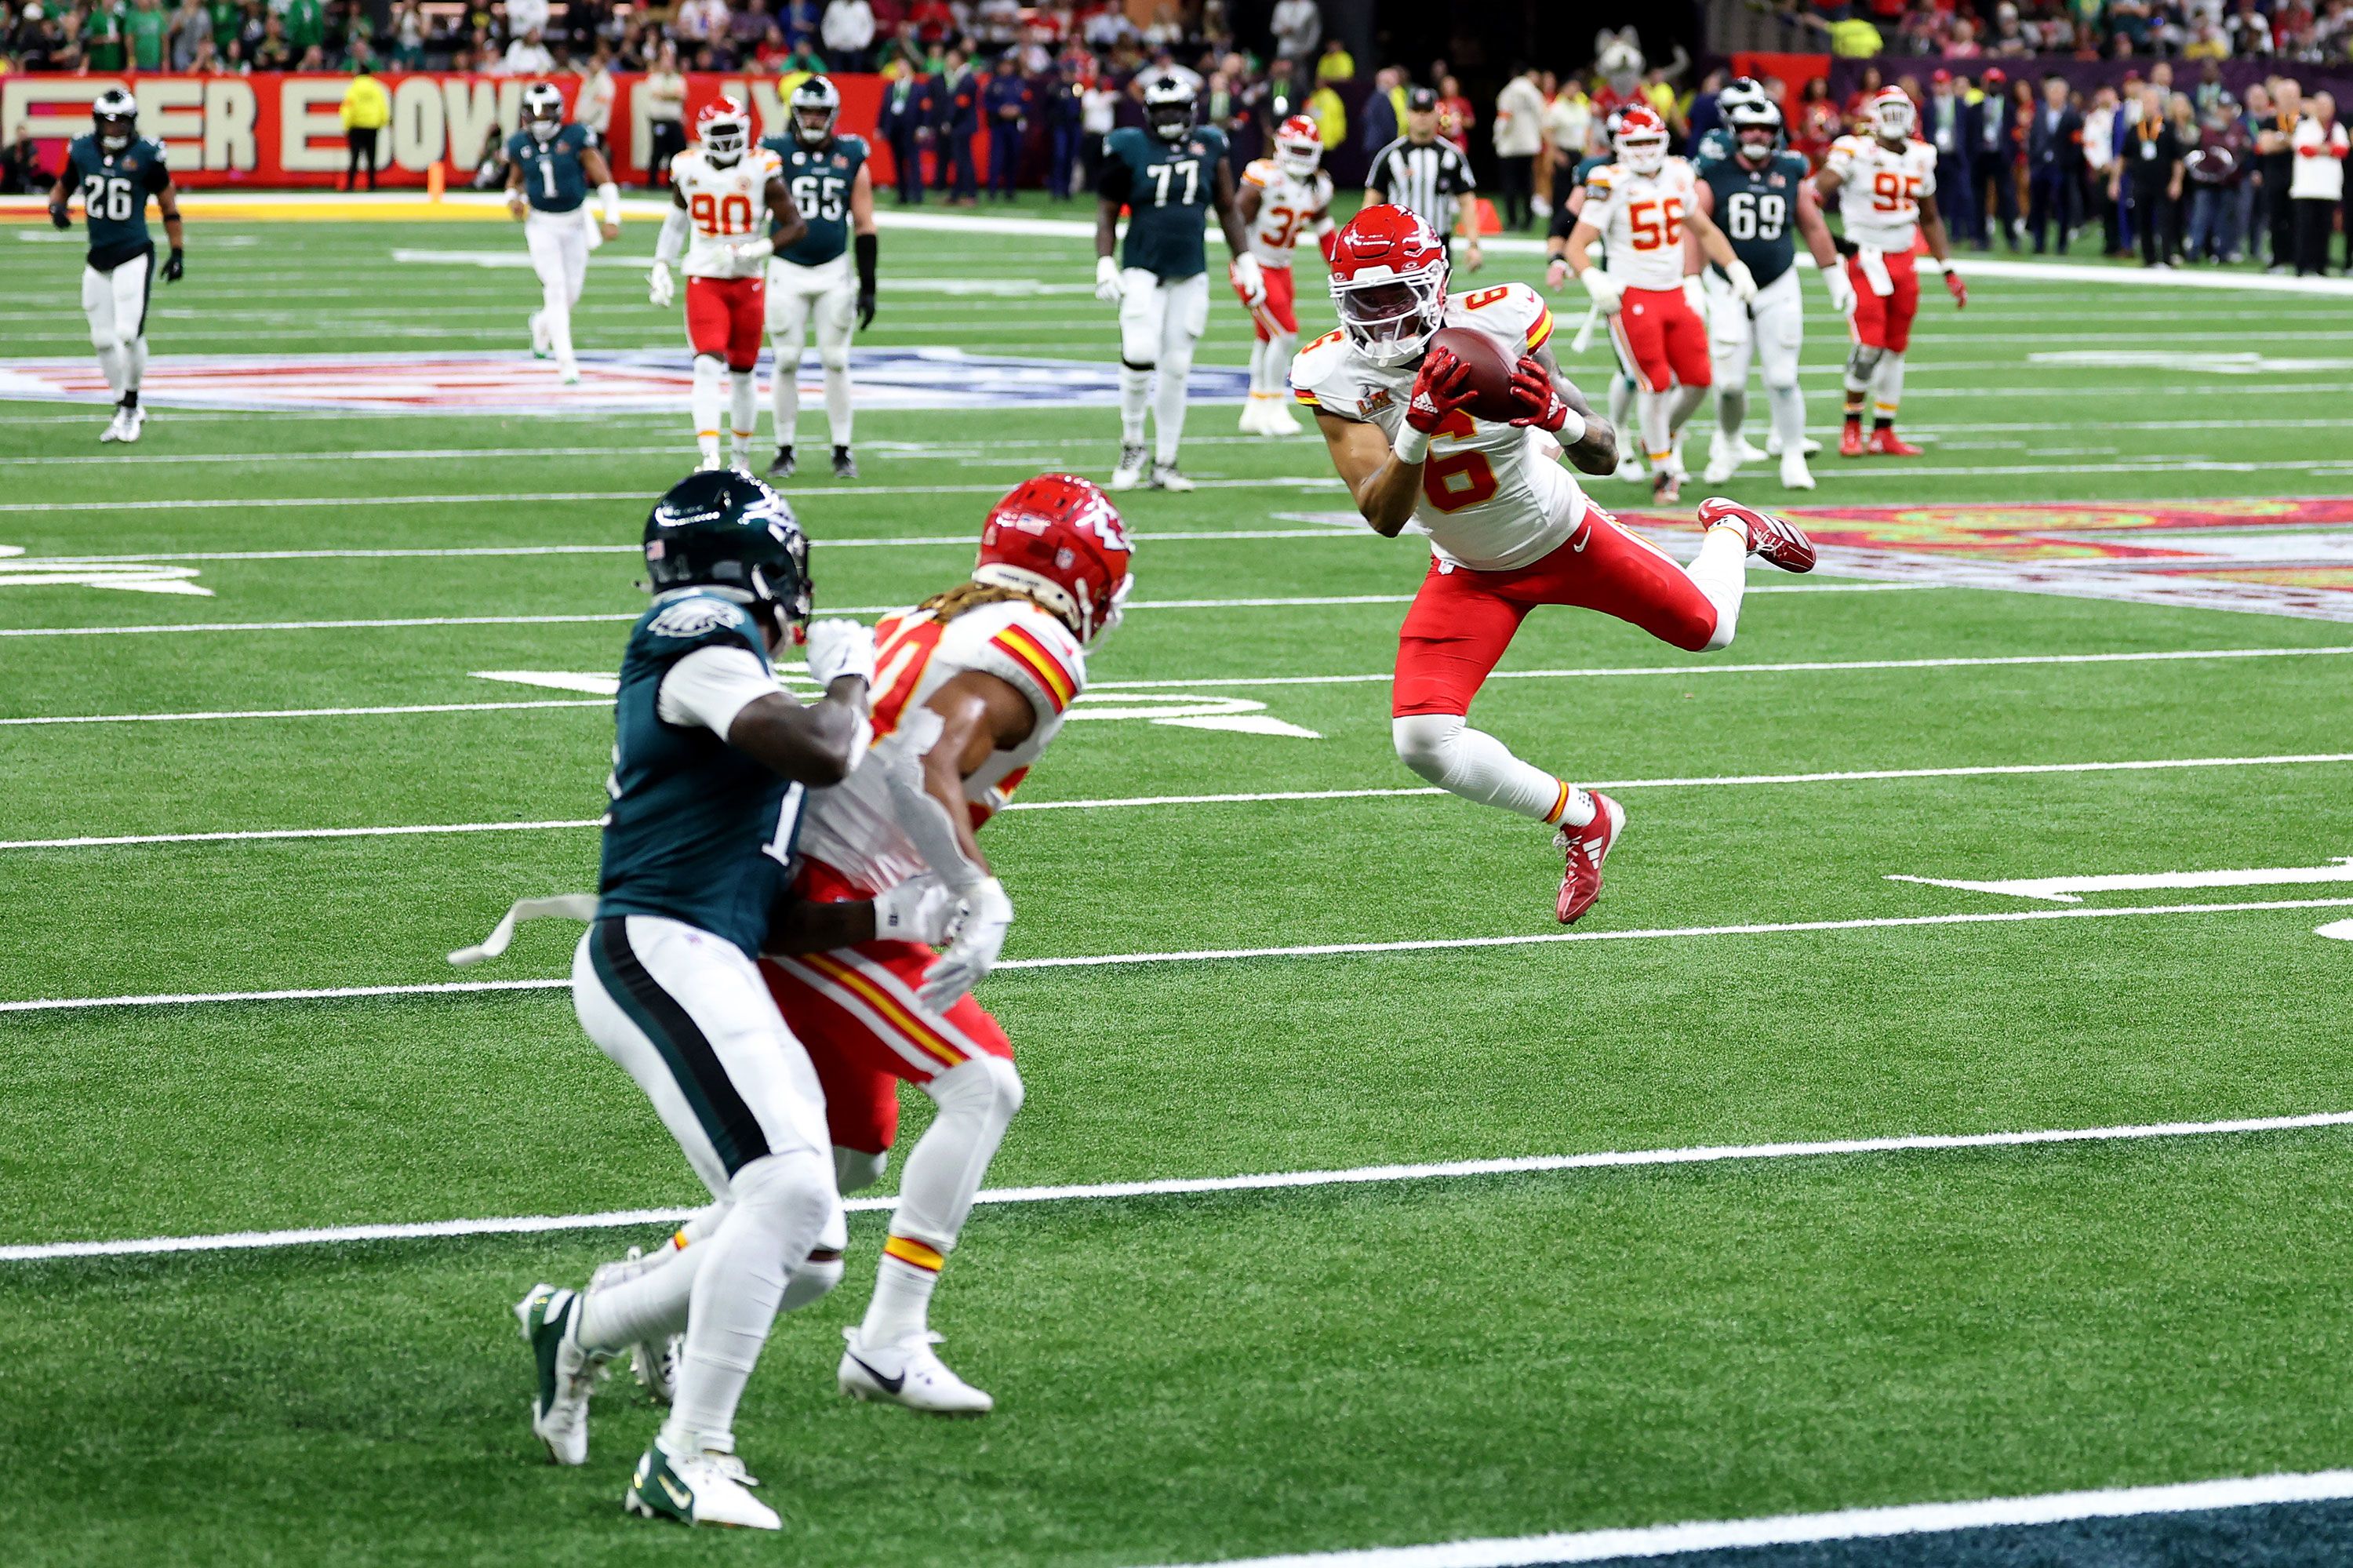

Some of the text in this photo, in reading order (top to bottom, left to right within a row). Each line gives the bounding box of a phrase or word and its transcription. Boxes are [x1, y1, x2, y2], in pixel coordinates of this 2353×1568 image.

[279, 77, 541, 172] BOW
[85, 174, 132, 220] 26
[538, 159, 559, 198] 1
[791, 175, 846, 222] 65
[1147, 159, 1199, 208] 77
[688, 193, 753, 237] 90
[1728, 192, 1786, 240] 69
[1423, 407, 1500, 515] 6
